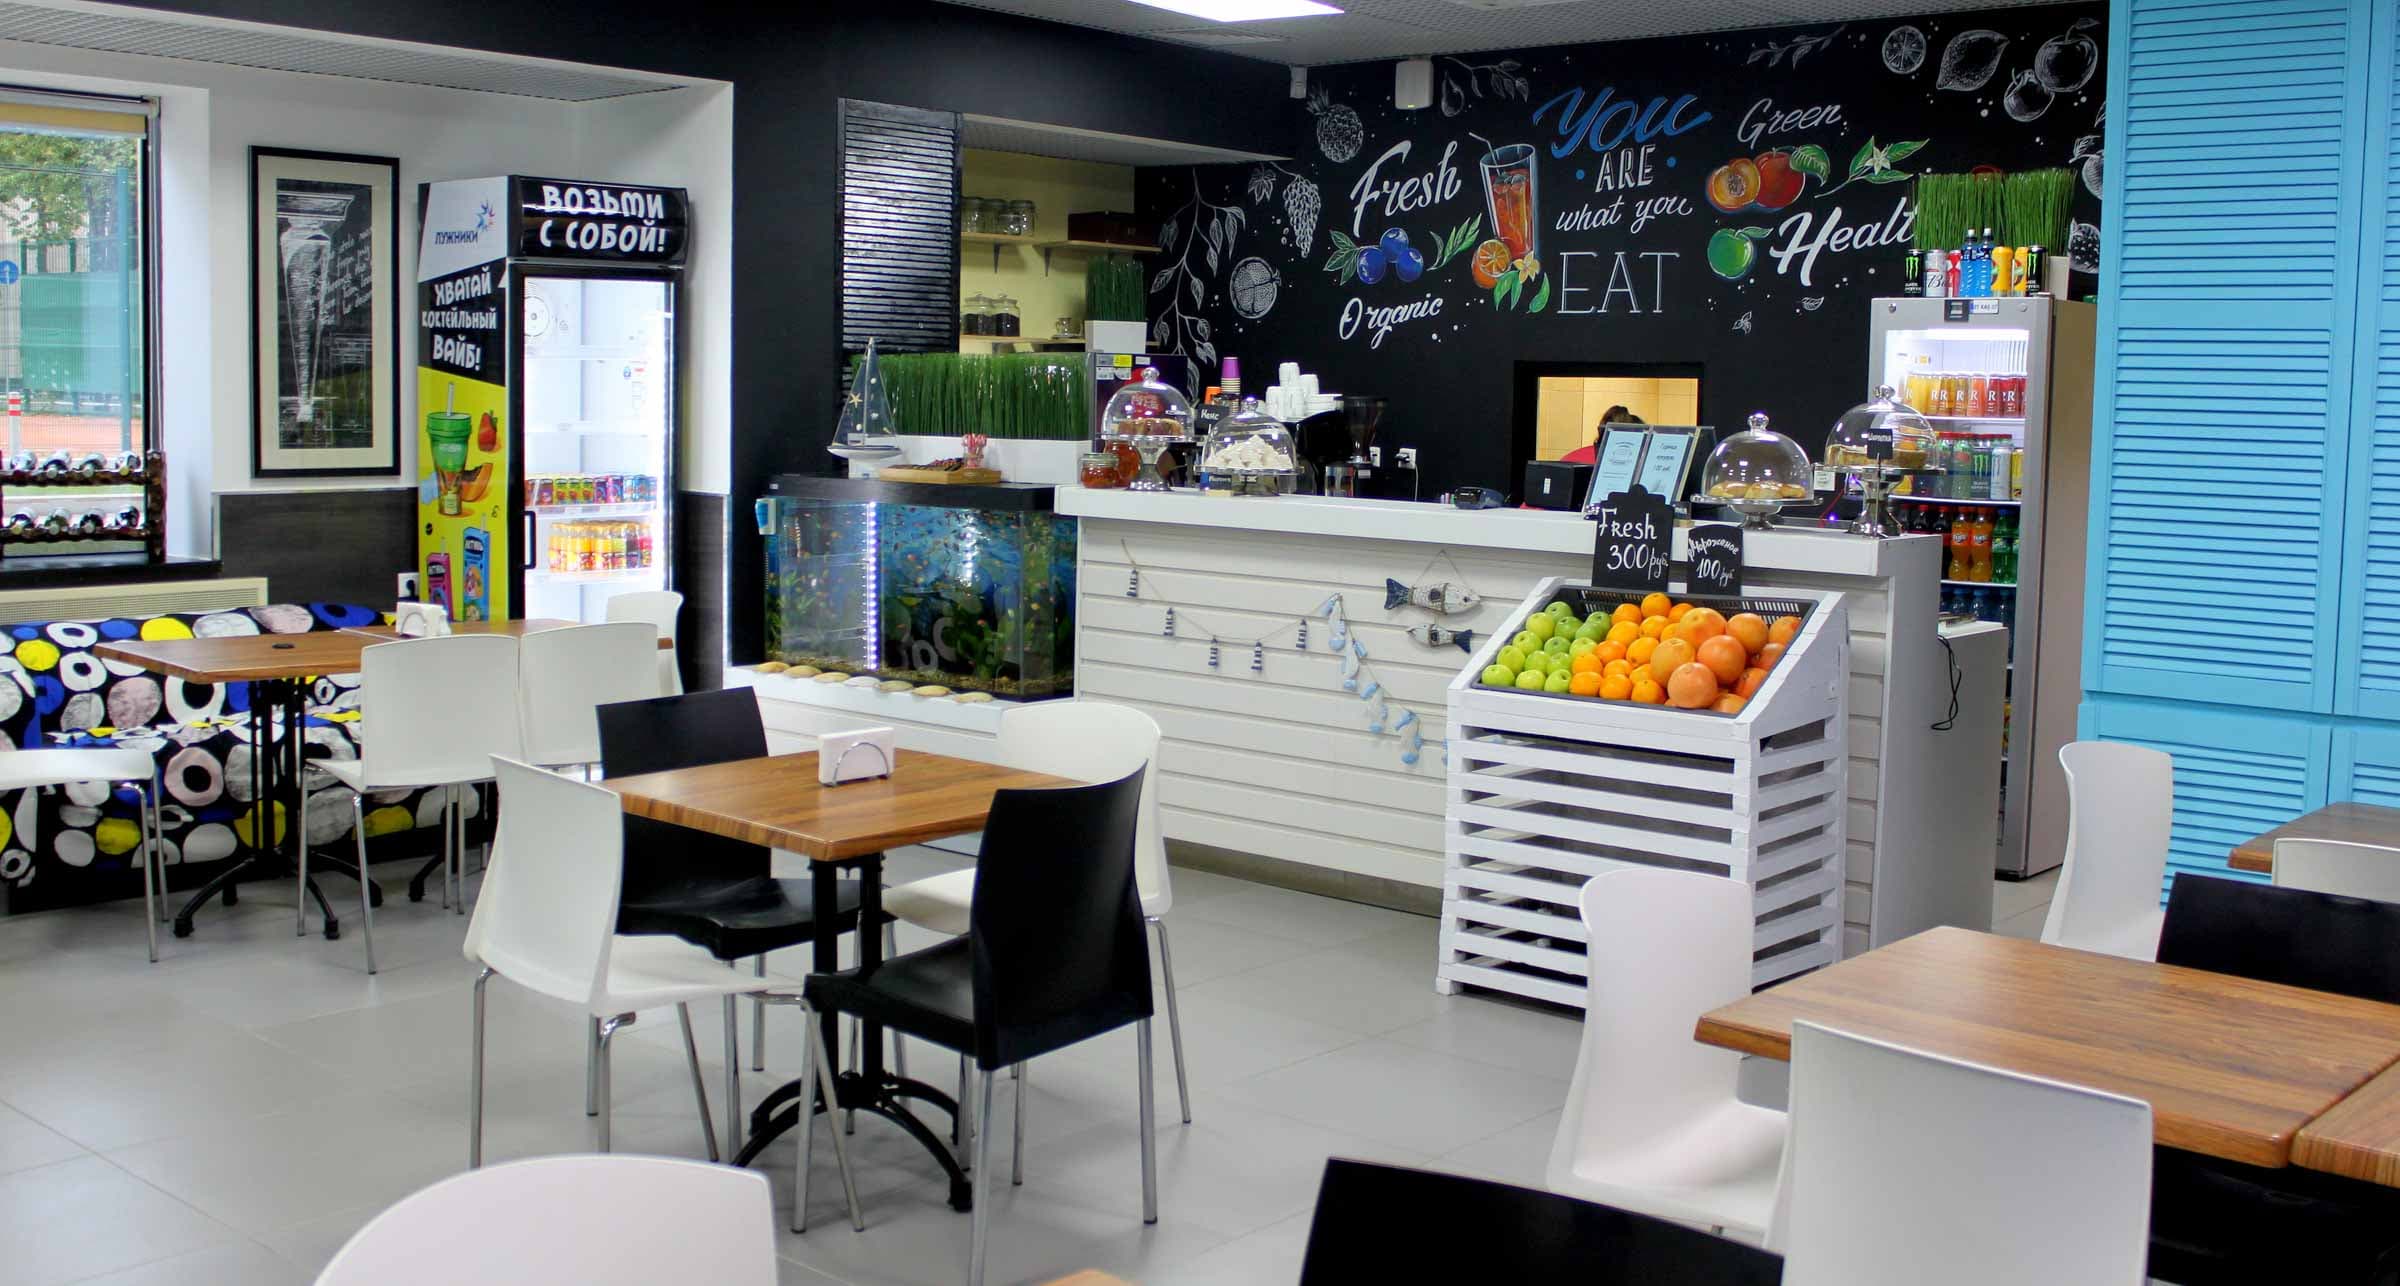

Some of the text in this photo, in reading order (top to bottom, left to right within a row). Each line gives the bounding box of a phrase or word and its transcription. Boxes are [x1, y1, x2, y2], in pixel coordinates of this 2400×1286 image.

[1532, 86, 1713, 159] You
[1737, 98, 1842, 150] Green
[1595, 144, 1656, 193] ARE
[541, 185, 664, 220] ВОЗЬМИ
[1350, 140, 1462, 238] Fresh
[1556, 195, 1693, 234] what you
[434, 230, 479, 245] ЛУЖНИКИ
[539, 217, 665, 252] С СОБОЙ!
[1769, 196, 1920, 286] Healt
[434, 266, 491, 306] ХВАТАЙ
[1557, 251, 1680, 314] EAT
[422, 307, 497, 329] КОКТЕЙЛЬНЫЙ
[1339, 293, 1444, 349] Organic
[433, 334, 481, 371] ВАЙБ!
[1599, 507, 1657, 541] Fresh
[1606, 544, 1649, 571] 300
[1696, 558, 1721, 580] 100
